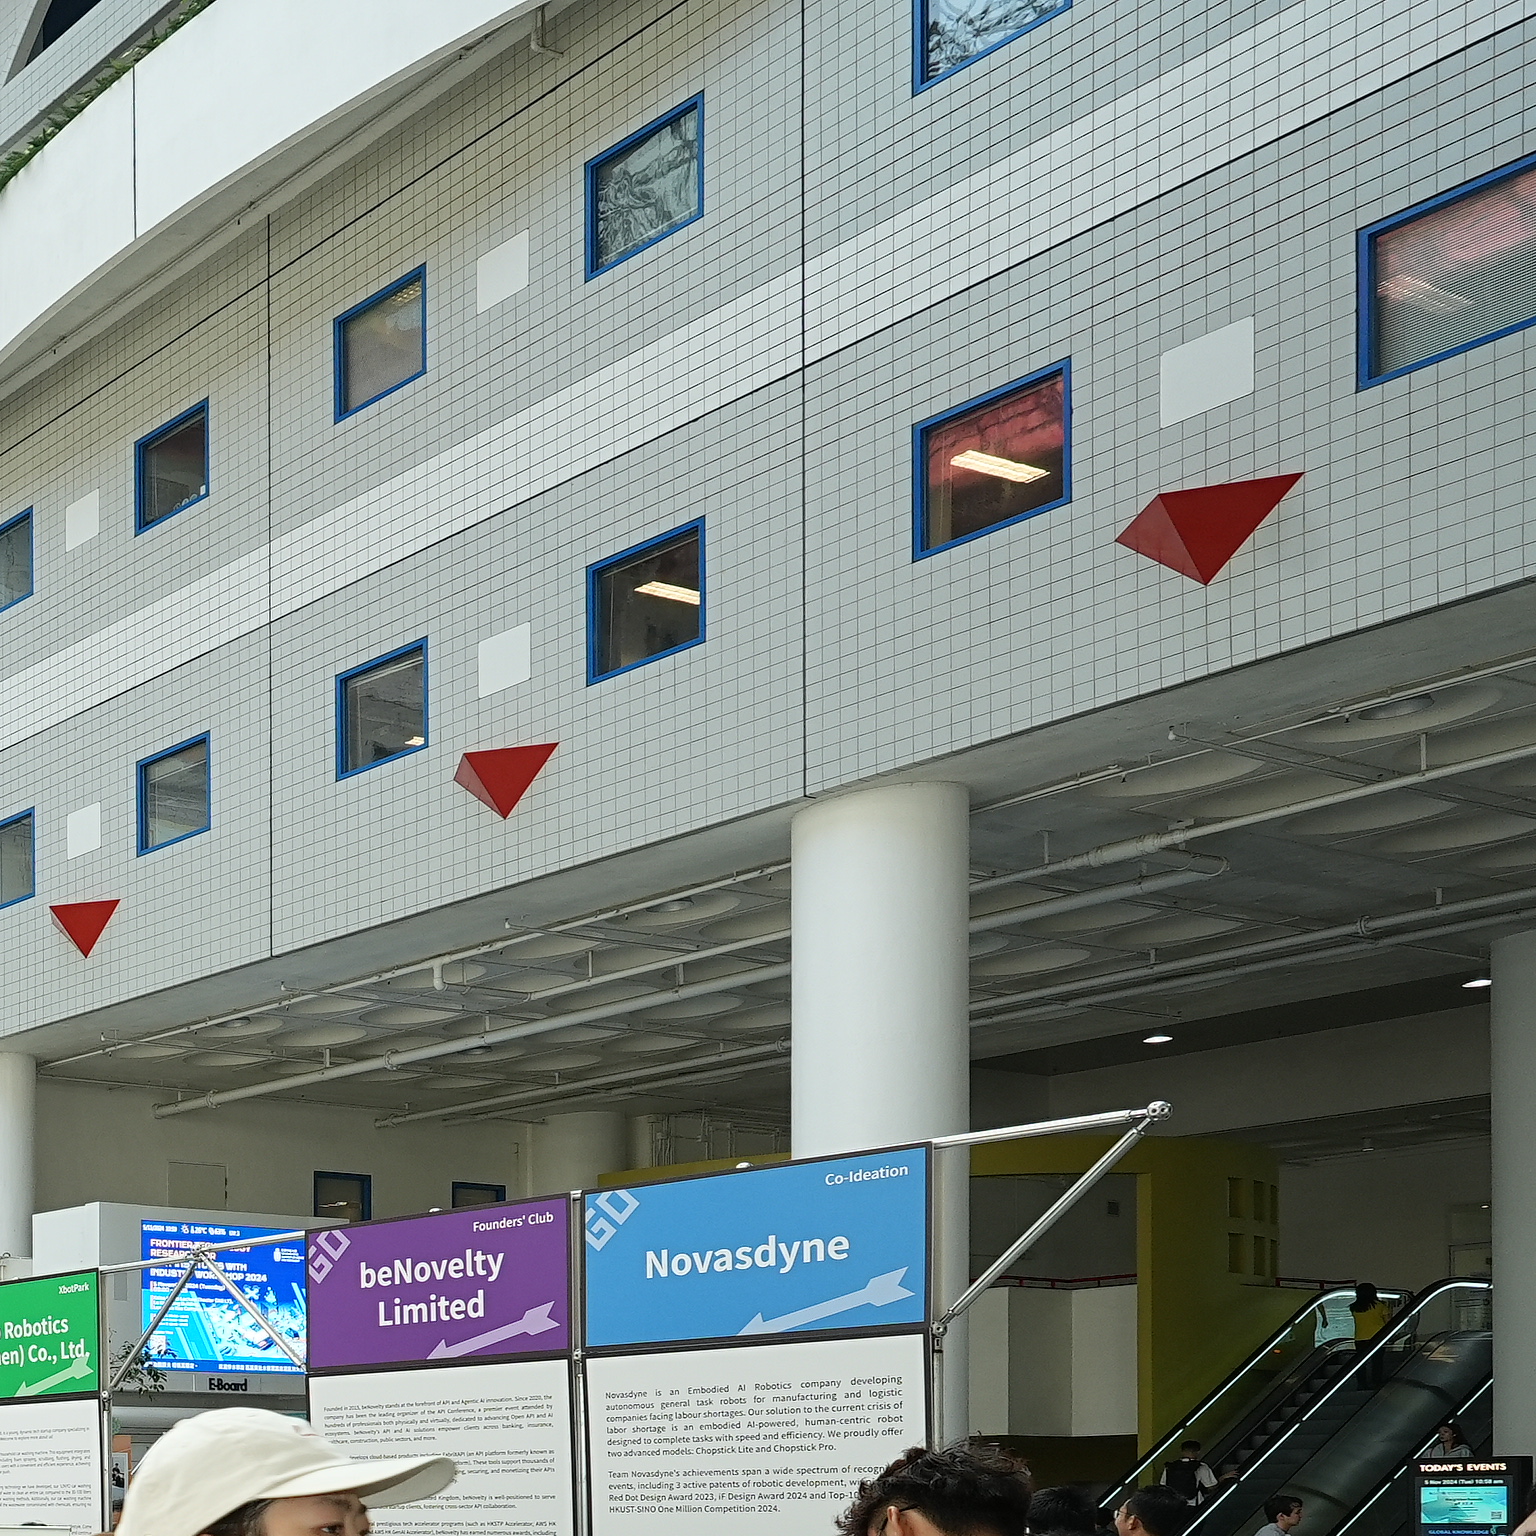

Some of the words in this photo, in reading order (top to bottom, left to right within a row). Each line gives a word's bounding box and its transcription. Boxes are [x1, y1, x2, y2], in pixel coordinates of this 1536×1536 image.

[825, 1164, 909, 1186] Co-Ideation
[472, 1215, 526, 1232] Founders'
[528, 1211, 554, 1225] Club
[226, 1262, 247, 1271] WITH
[646, 1235, 850, 1279] Novasdyne
[245, 1273, 268, 1282] 2024
[360, 1248, 505, 1289] beNovelty
[58, 1282, 90, 1295] XbotPark
[378, 1289, 485, 1327] Limited
[4, 1316, 69, 1340] Robotics
[28, 1344, 57, 1363] Co.,
[60, 1339, 91, 1359] Ltd.
[209, 1378, 248, 1392] E-Board
[605, 1390, 647, 1399] Novasdyne
[655, 1388, 662, 1397] is
[688, 1384, 729, 1395] Embodied
[755, 1382, 792, 1391] Robotics
[800, 1380, 841, 1389] company
[850, 1375, 902, 1386] developing
[605, 1402, 654, 1411] autonomous
[660, 1399, 690, 1410] general
[696, 1397, 713, 1406] task
[720, 1396, 747, 1405] robots
[753, 1394, 765, 1403] for
[772, 1391, 837, 1402] manufacturing
[844, 1389, 862, 1399] and
[869, 1387, 903, 1399] logistic
[606, 1414, 647, 1423] companies
[649, 1412, 673, 1422] facing
[675, 1411, 702, 1419] labour
[703, 1410, 746, 1419] shortages.
[748, 1408, 763, 1416] Our
[765, 1406, 801, 1415] solution
[803, 1406, 812, 1414] to
[814, 1404, 829, 1413] the
[831, 1404, 864, 1412] current
[867, 1401, 891, 1411] crisis
[893, 1400, 903, 1409] of
[606, 1426, 627, 1434] labor
[632, 1425, 666, 1434] shortage
[671, 1423, 678, 1431] is
[699, 1421, 741, 1430] embodied
[746, 1418, 799, 1429] AI-powered,
[805, 1417, 871, 1426] human-centric
[877, 1414, 903, 1423] robot
[607, 1437, 641, 1447] designed
[643, 1437, 651, 1445] to
[653, 1435, 690, 1445] complete
[692, 1434, 713, 1443] tasks
[714, 1433, 733, 1442] with
[735, 1432, 760, 1442] speed
[762, 1431, 779, 1440] and
[781, 1430, 825, 1440] efficiency.
[827, 1430, 841, 1438] We
[843, 1428, 879, 1439] proudly
[881, 1427, 904, 1436] offer
[623, 1448, 660, 1457] advanced
[662, 1447, 694, 1456] models:
[695, 1445, 736, 1455] Chopstick
[738, 1446, 753, 1454] Lite
[755, 1444, 772, 1453] and
[773, 1443, 817, 1453] Chopstick
[818, 1442, 836, 1451] Pro.
[1419, 1464, 1464, 1472] TODAY'S
[1467, 1463, 1507, 1471] EVENTS
[609, 1505, 656, 1513] HKUST-SINO
[658, 1505, 674, 1513] One
[675, 1504, 702, 1513] Million
[704, 1504, 756, 1514] Competition
[757, 1504, 780, 1512] 2024.
